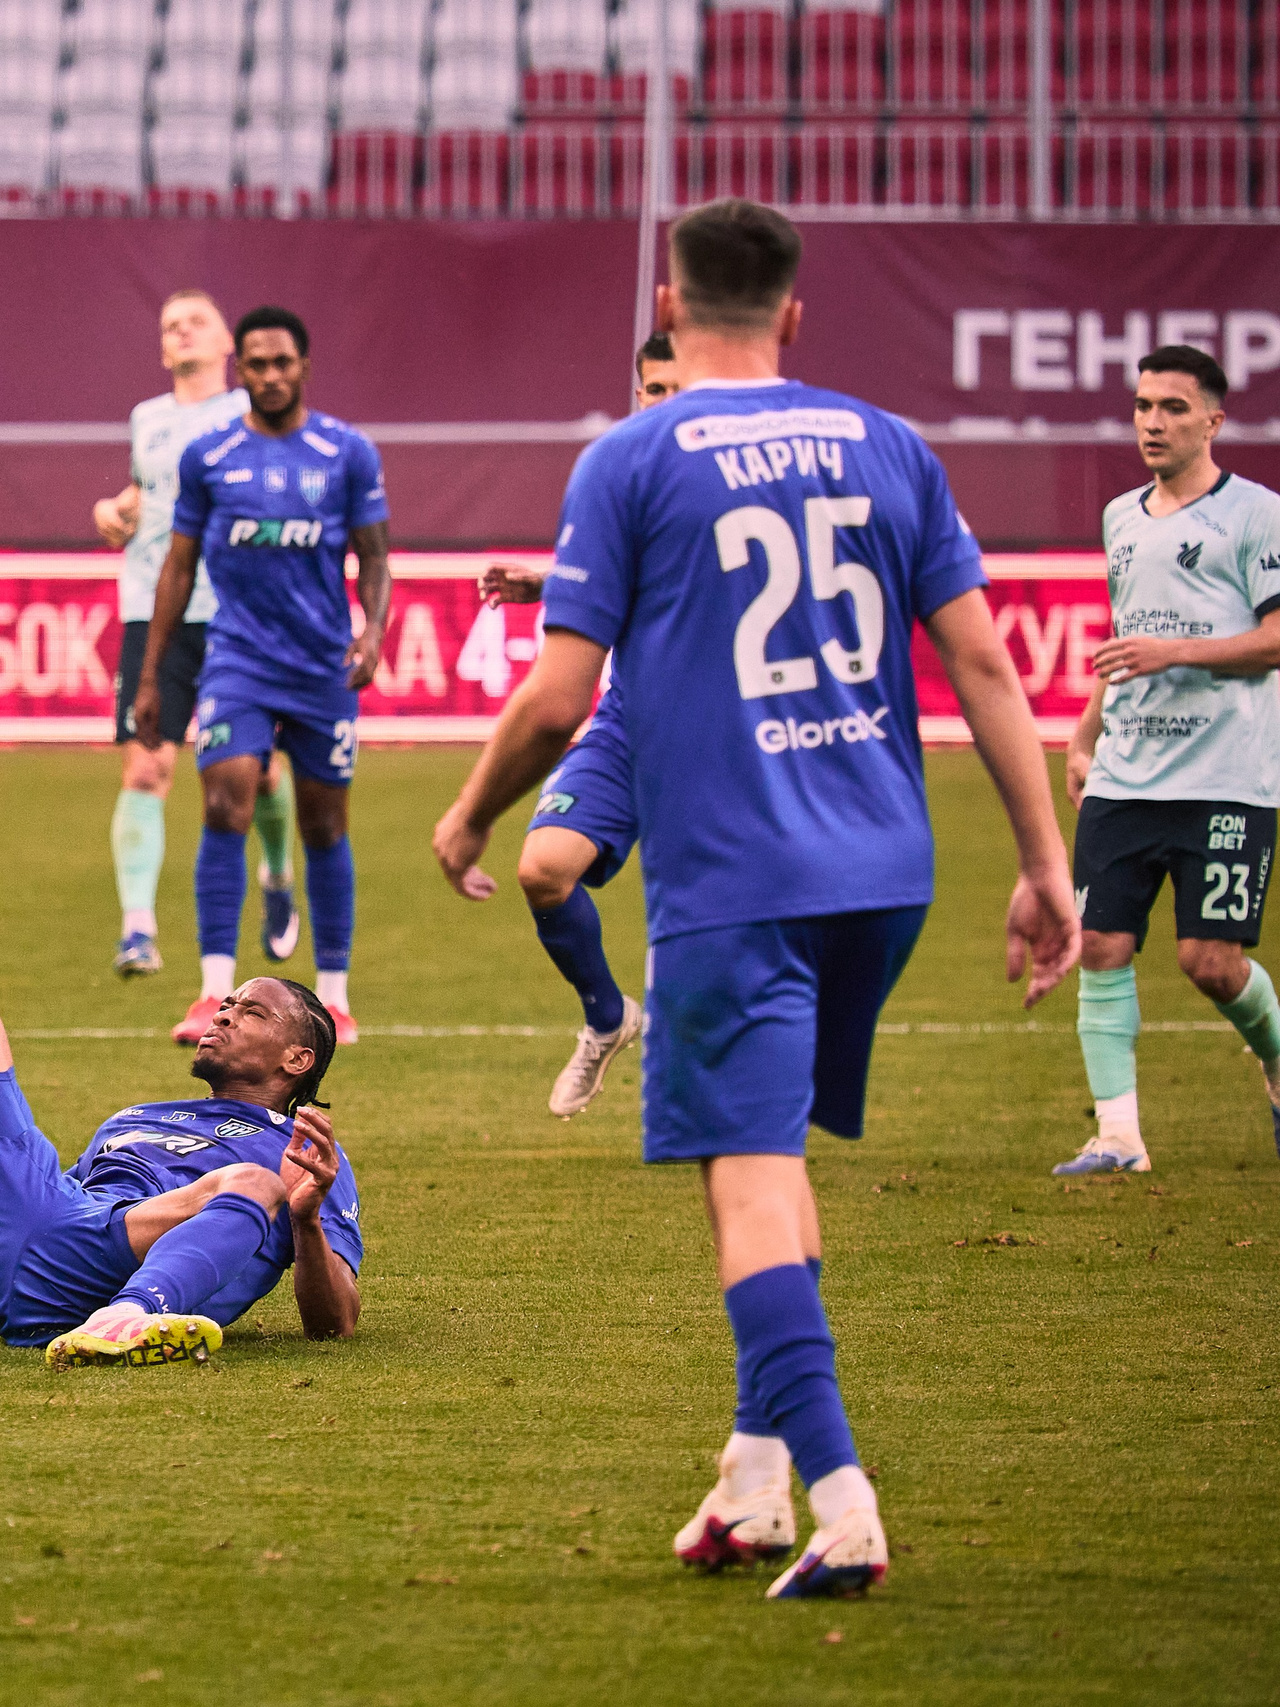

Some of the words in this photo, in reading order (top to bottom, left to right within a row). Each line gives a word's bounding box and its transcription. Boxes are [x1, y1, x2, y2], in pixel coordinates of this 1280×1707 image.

[713, 437, 844, 491] КАРИЧ
[714, 497, 885, 700] 25
[1208, 814, 1246, 833] FON
[1208, 832, 1247, 850] BET
[1200, 861, 1250, 922] 23
